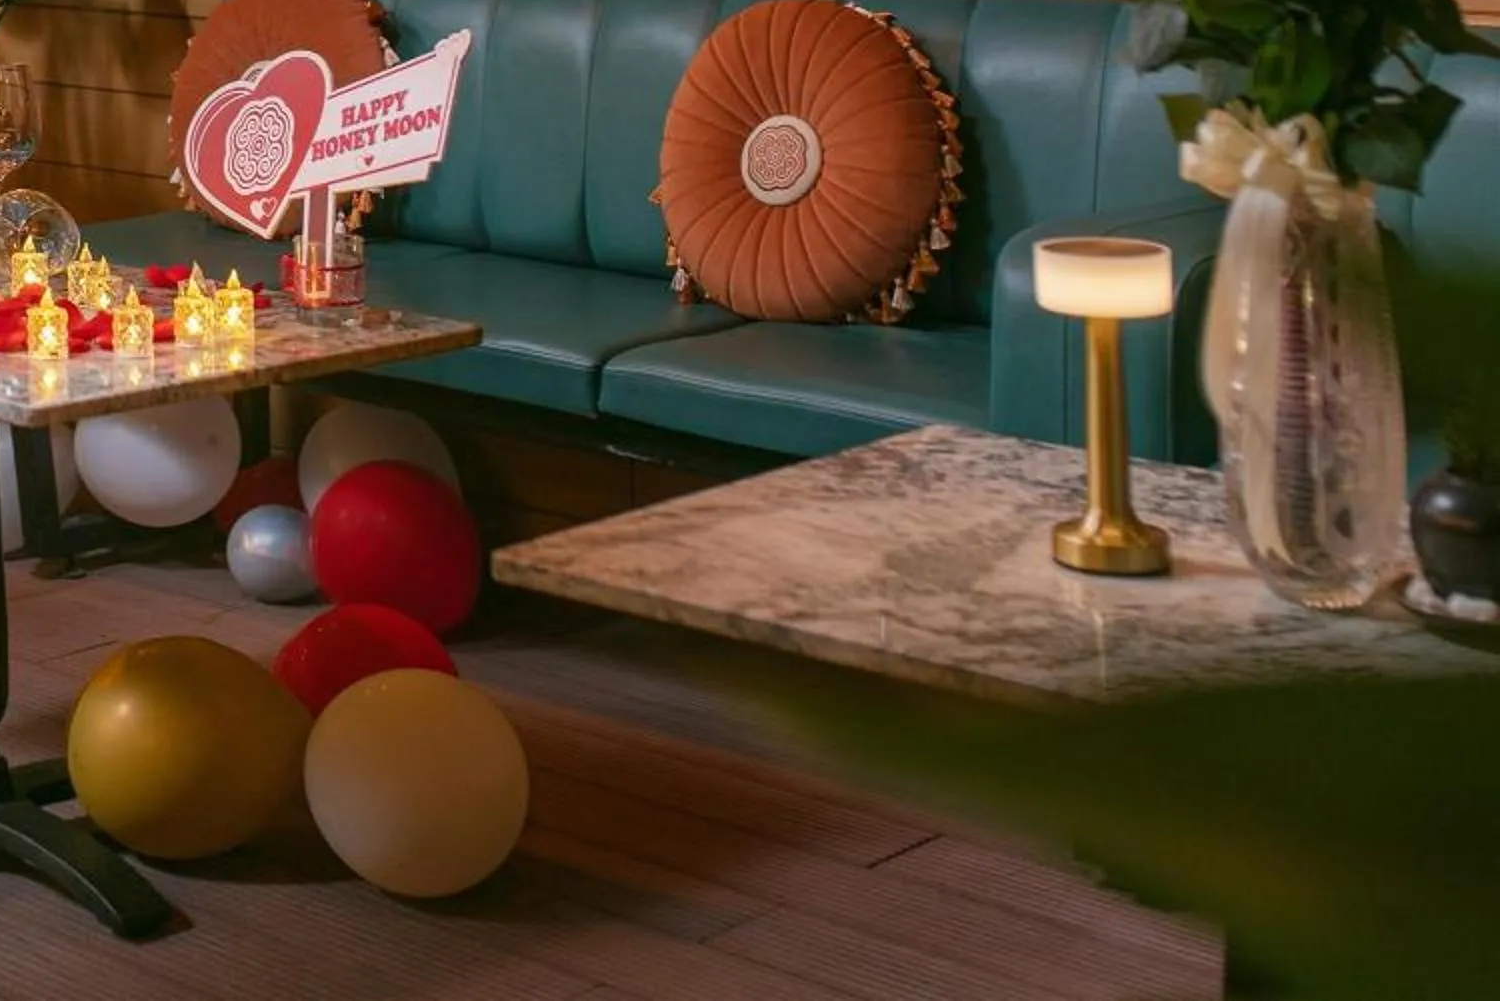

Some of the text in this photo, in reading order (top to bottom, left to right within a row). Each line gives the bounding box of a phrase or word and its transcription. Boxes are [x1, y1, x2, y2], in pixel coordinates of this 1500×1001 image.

[341, 89, 408, 128] HAPPY
[311, 104, 442, 162] HONEY MOON
